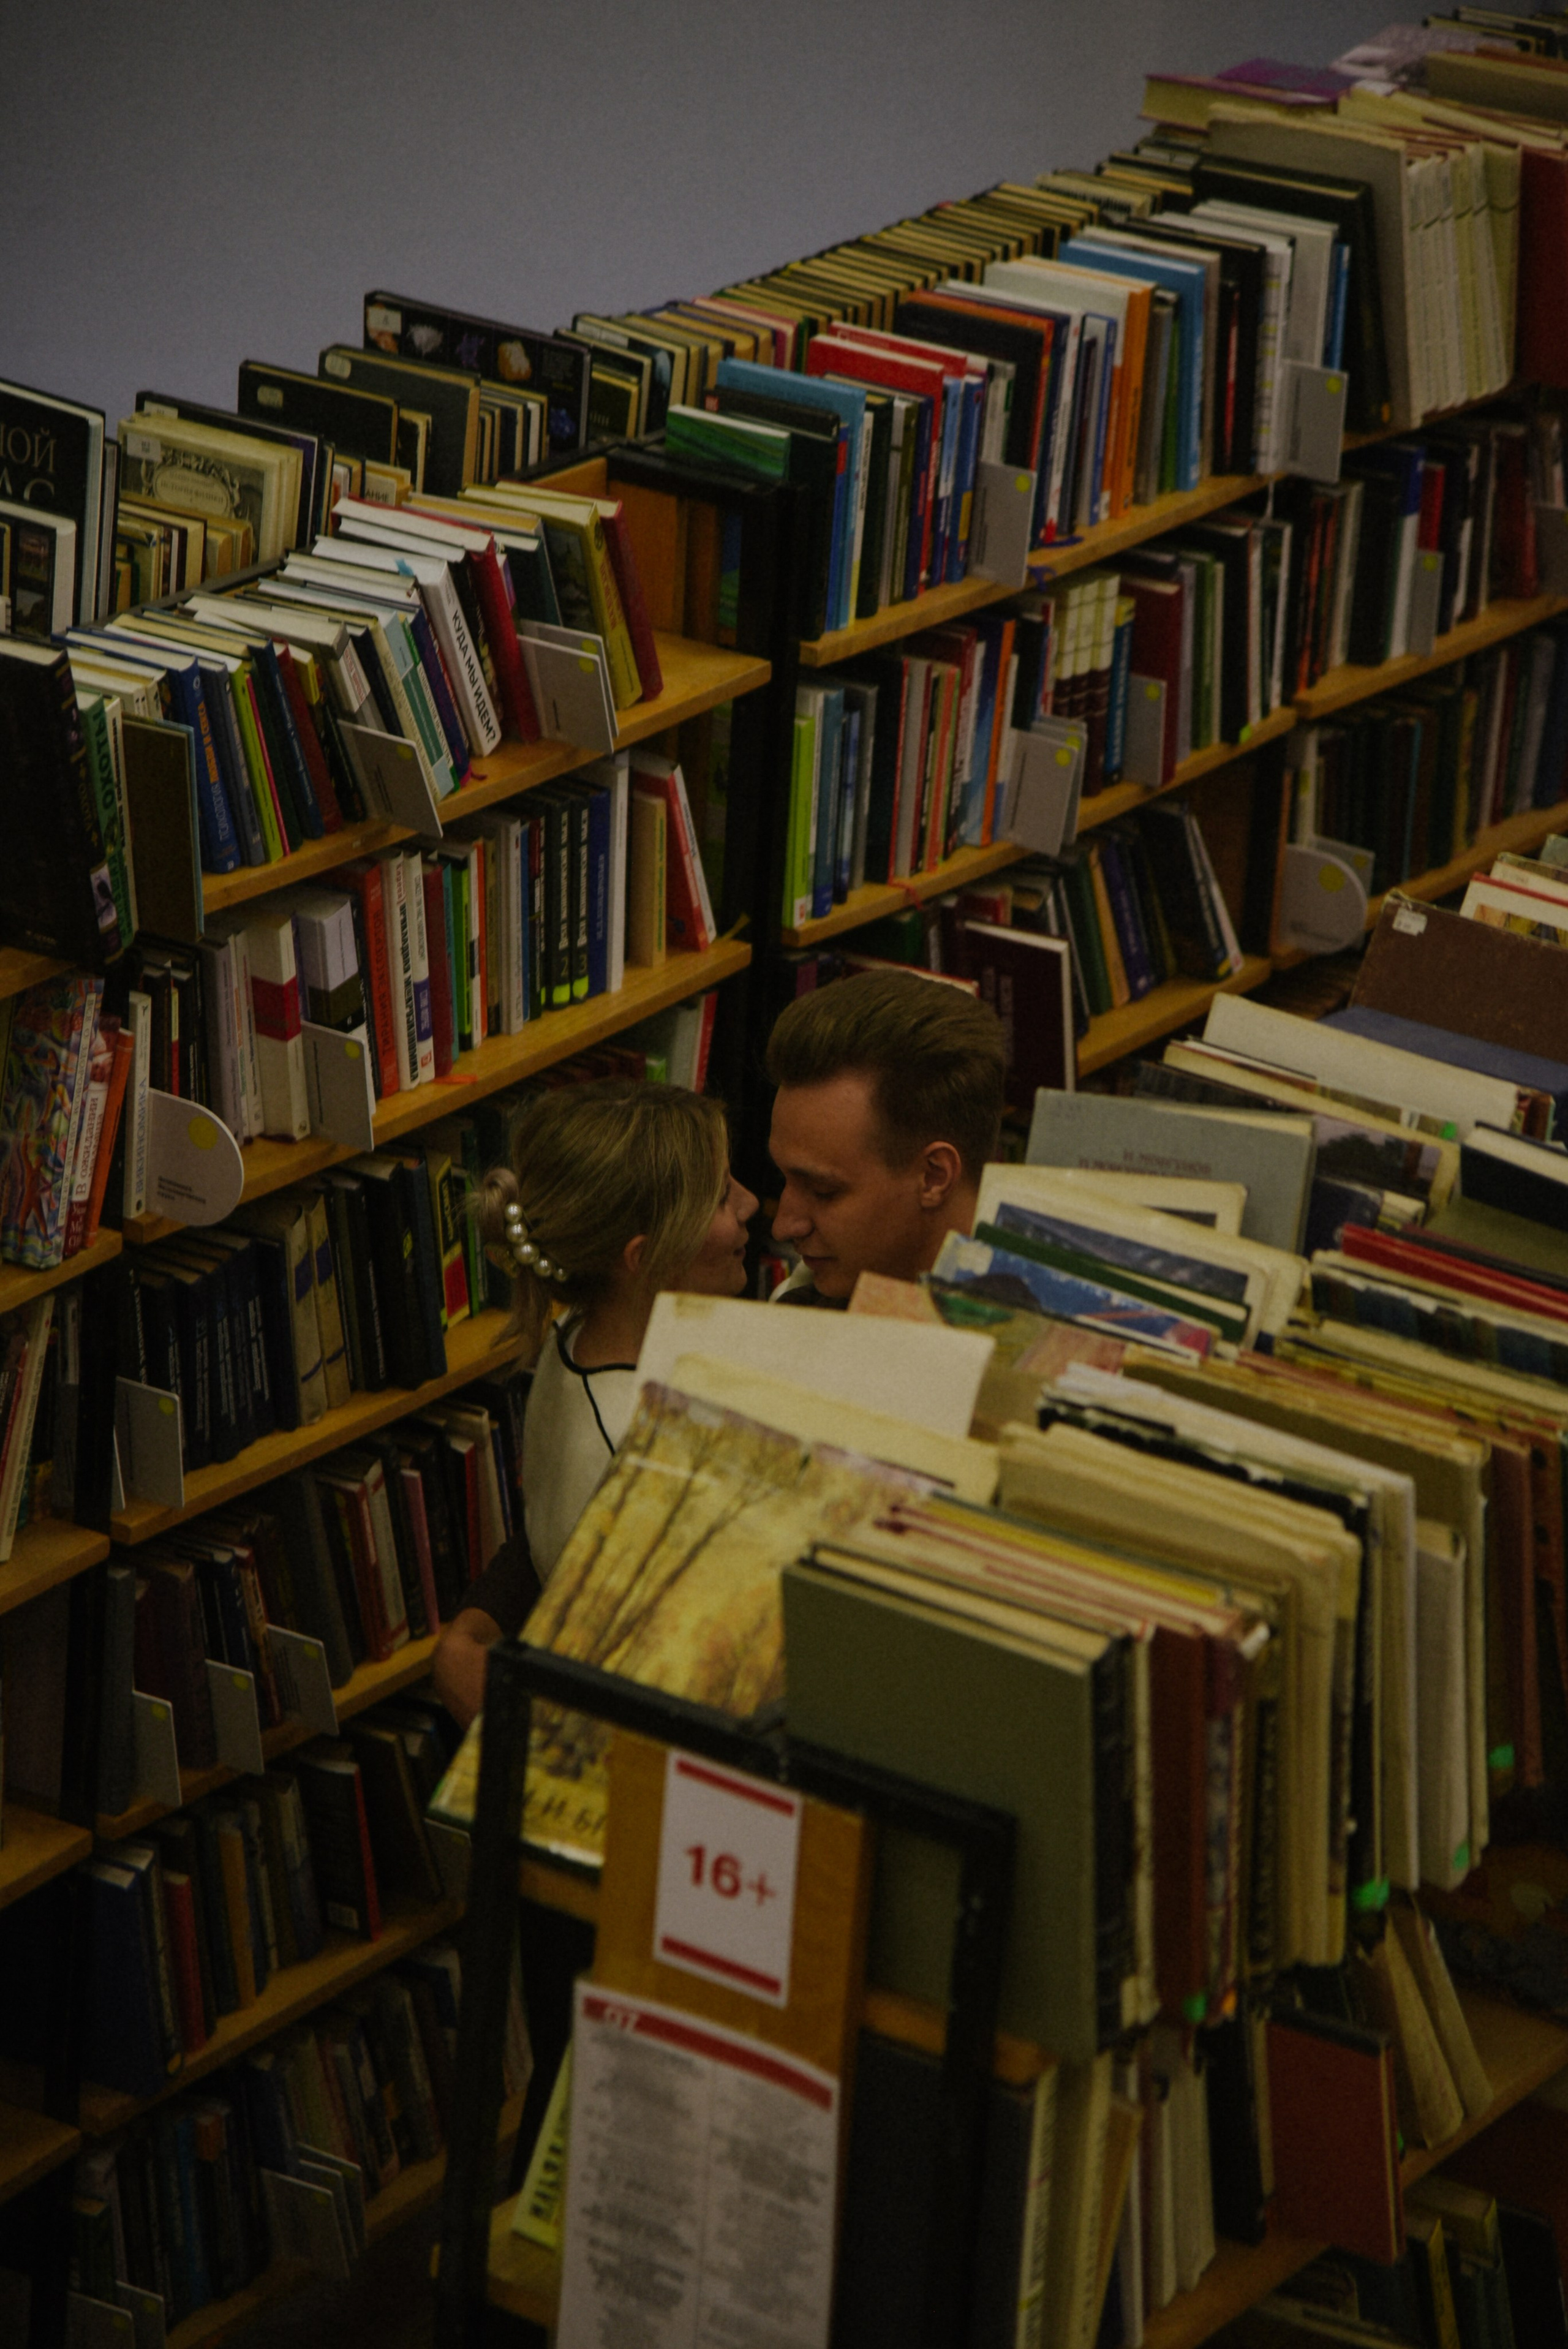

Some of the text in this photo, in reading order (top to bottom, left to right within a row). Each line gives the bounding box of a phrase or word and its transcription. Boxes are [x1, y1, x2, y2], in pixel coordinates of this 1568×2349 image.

[0, 423, 57, 474] ОЙ
[452, 610, 496, 743] КУДА МЫ ИДЕМ?
[92, 709, 115, 810] ОХОТЫ
[211, 782, 230, 842] ПСИХОЛОГИЯ
[373, 910, 392, 1057] ТИРАНИЯ ЭКСПЕРТОВ
[400, 903, 411, 974] ПРИКЛАДНАЯ
[75, 1096, 99, 1196] В ожидании
[135, 1076, 146, 1196] ВИКИНОМИКА
[685, 1844, 777, 1907] 16+
